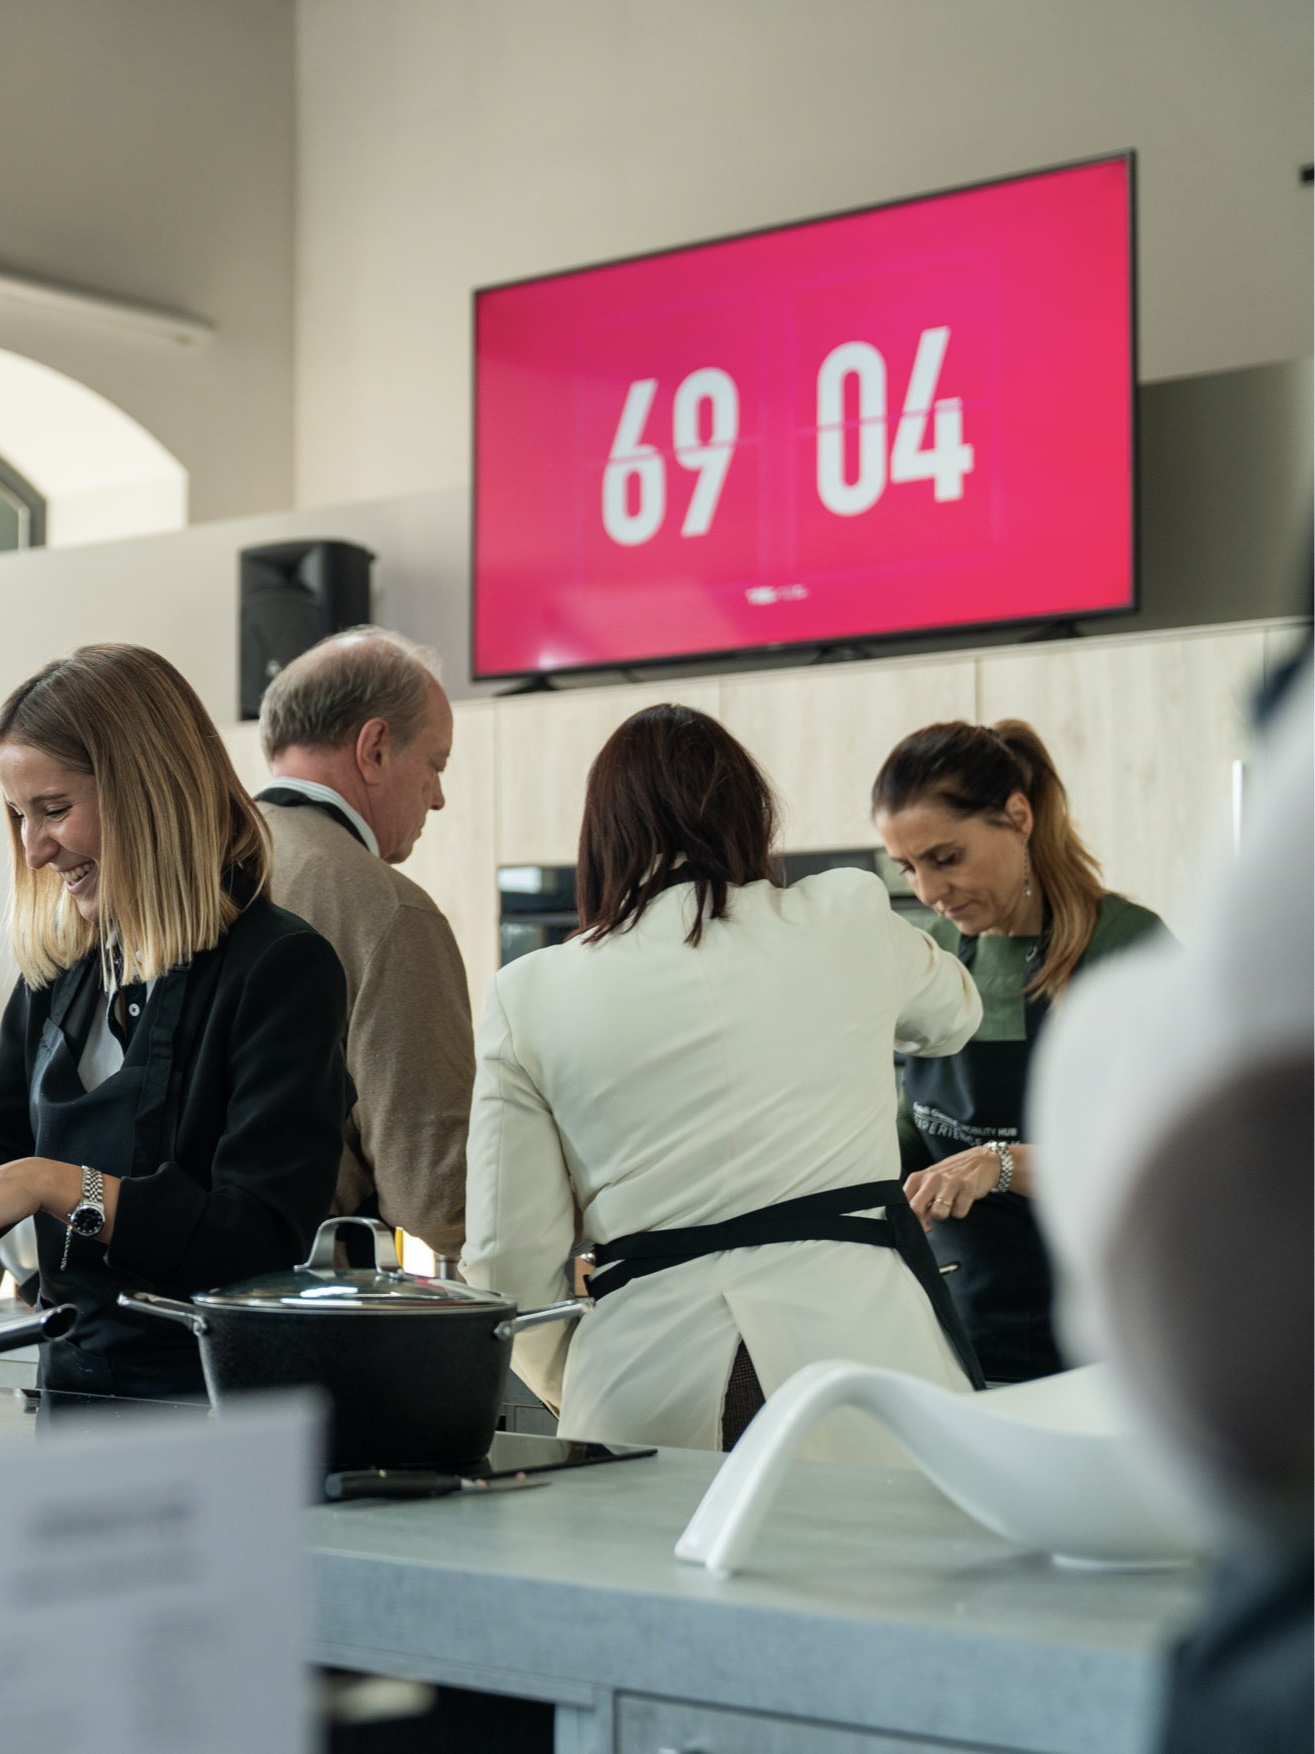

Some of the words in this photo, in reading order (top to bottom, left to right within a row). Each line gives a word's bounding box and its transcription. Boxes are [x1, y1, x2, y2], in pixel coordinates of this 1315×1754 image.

[601, 367, 740, 547] 69
[816, 325, 975, 517] 04
[915, 1116, 983, 1147] PERIENCE
